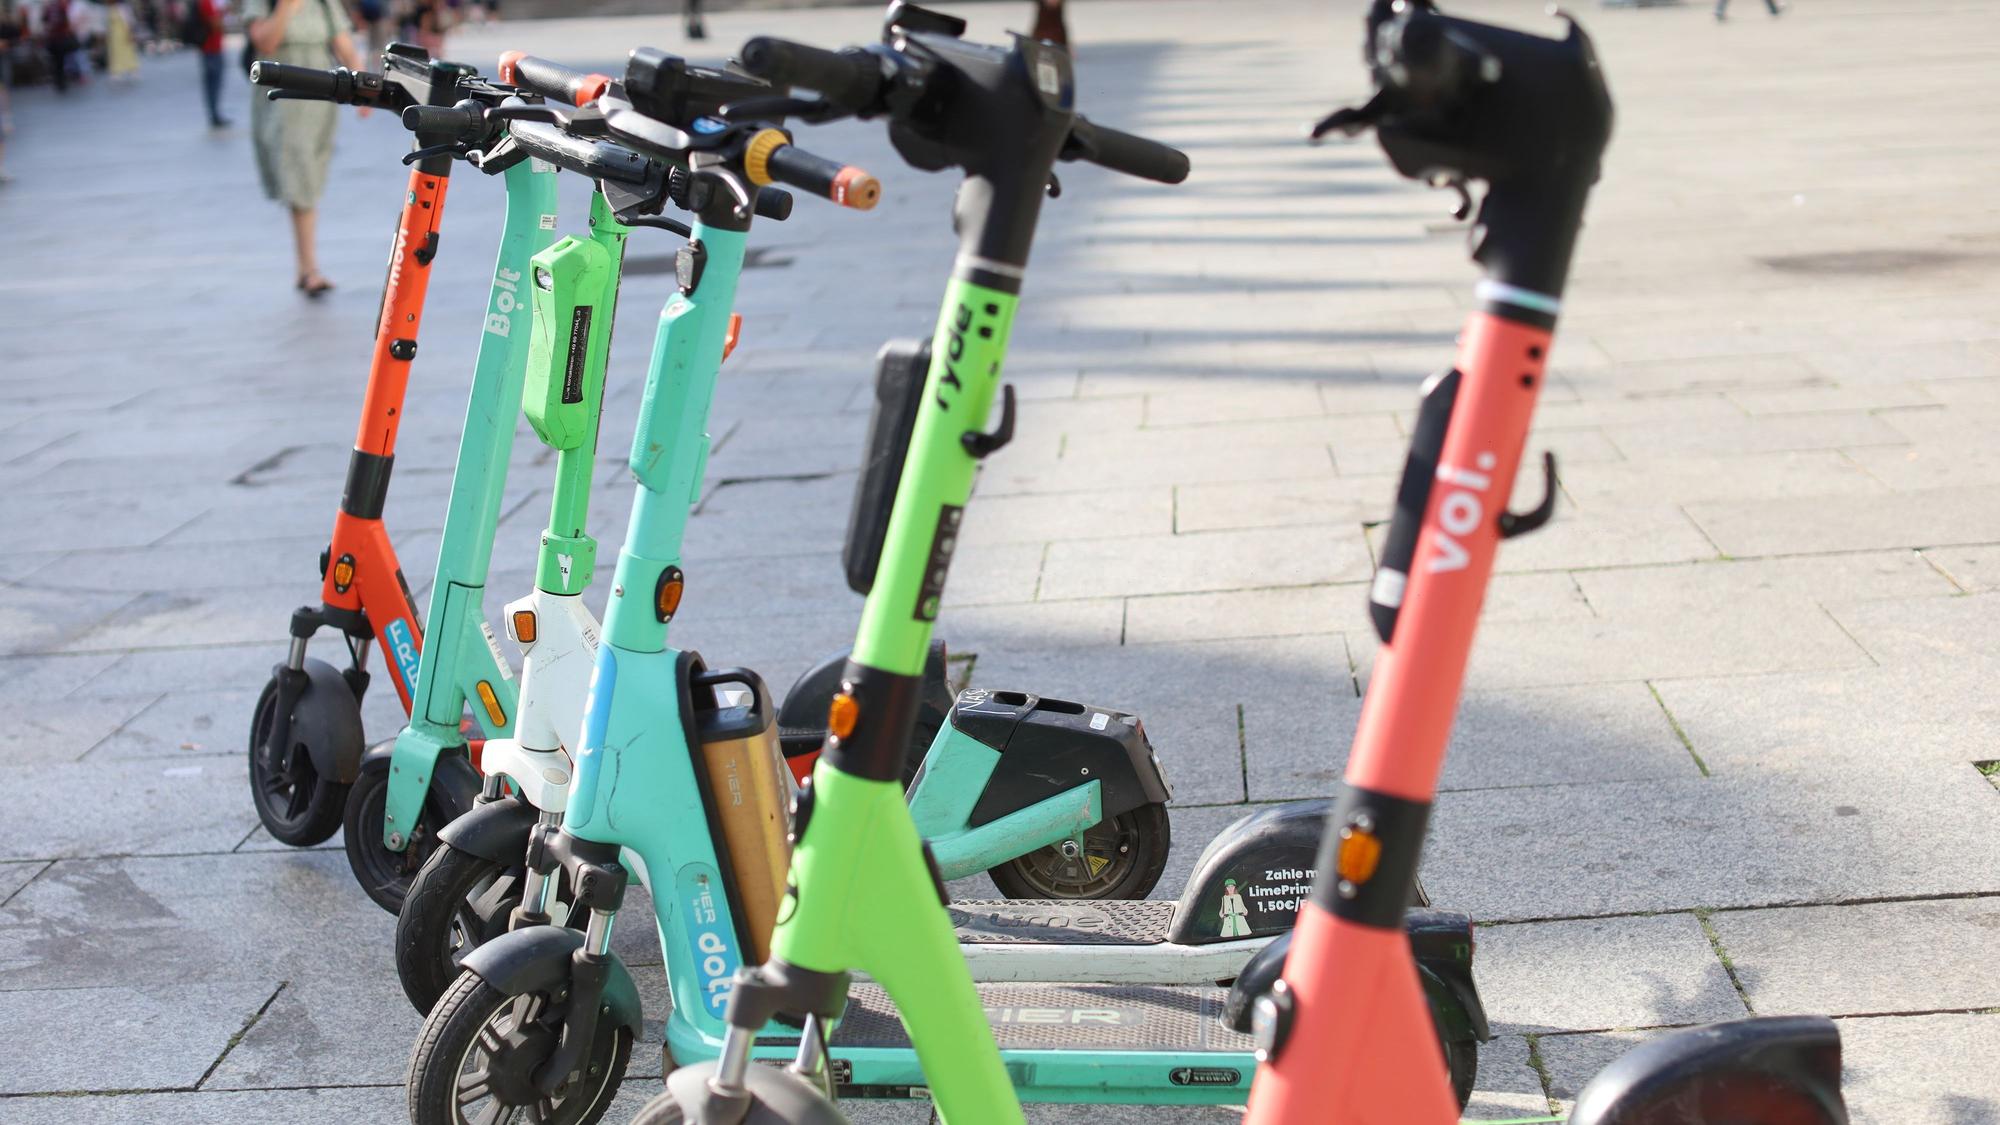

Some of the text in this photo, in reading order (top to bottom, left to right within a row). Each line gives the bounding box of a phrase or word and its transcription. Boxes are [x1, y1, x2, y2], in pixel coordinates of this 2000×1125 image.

[485, 267, 524, 338] Bolt
[936, 303, 972, 411] ryde
[1426, 452, 1497, 573] voi.
[726, 759, 742, 807] TIER
[1249, 883, 1313, 897] LimePrim
[1265, 868, 1319, 881] Zahle m
[697, 881, 716, 924] TIER
[1258, 896, 1307, 913] 1,50€/F
